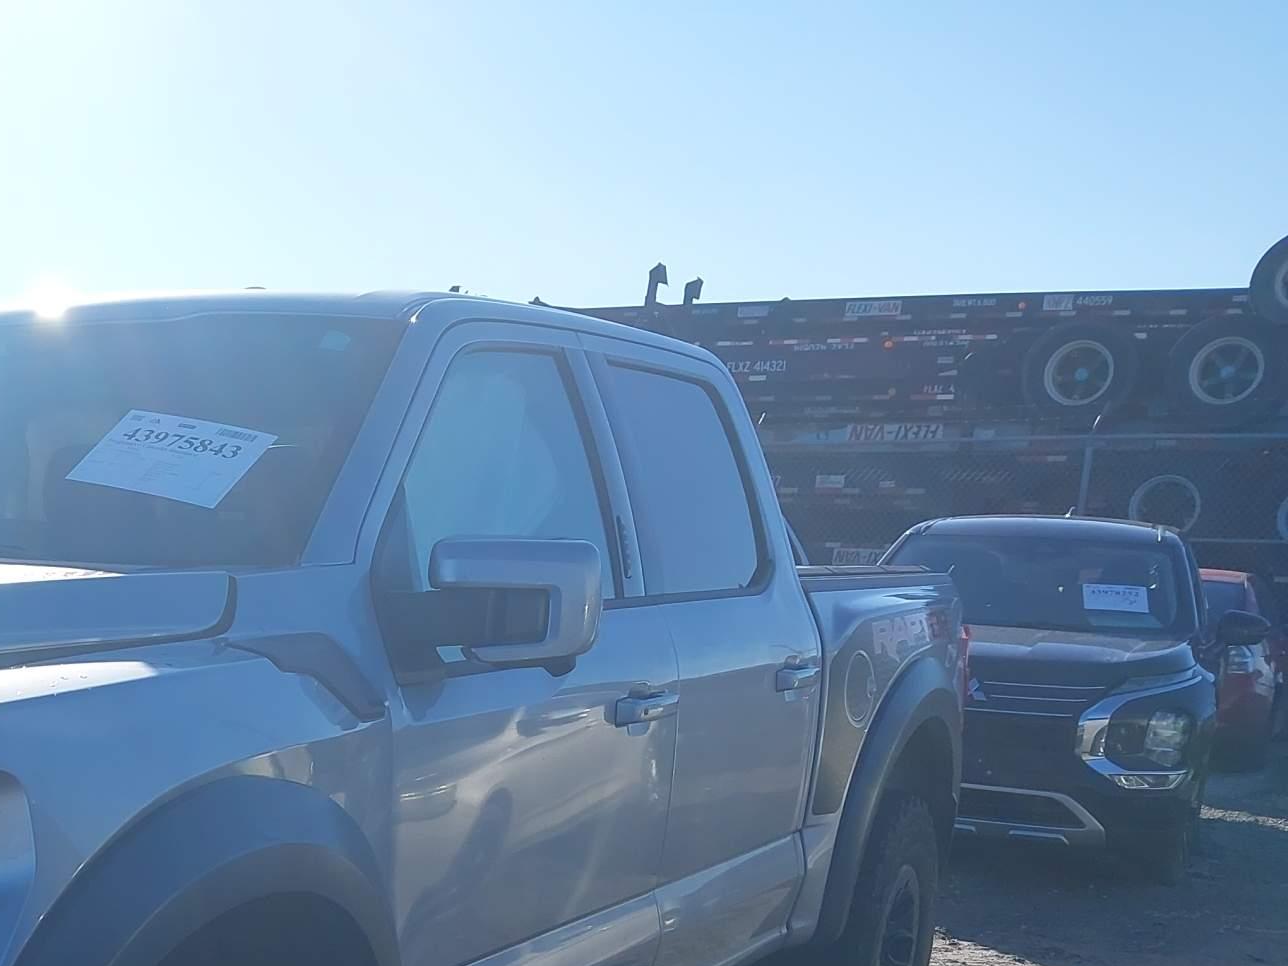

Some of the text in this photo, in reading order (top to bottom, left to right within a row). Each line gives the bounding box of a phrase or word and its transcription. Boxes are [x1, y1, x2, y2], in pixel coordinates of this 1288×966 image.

[846, 302, 901, 315] FLEXI-VAN
[753, 360, 786, 372] 414321
[850, 424, 939, 441] FLEXI-VAN
[123, 427, 242, 459] 43975843
